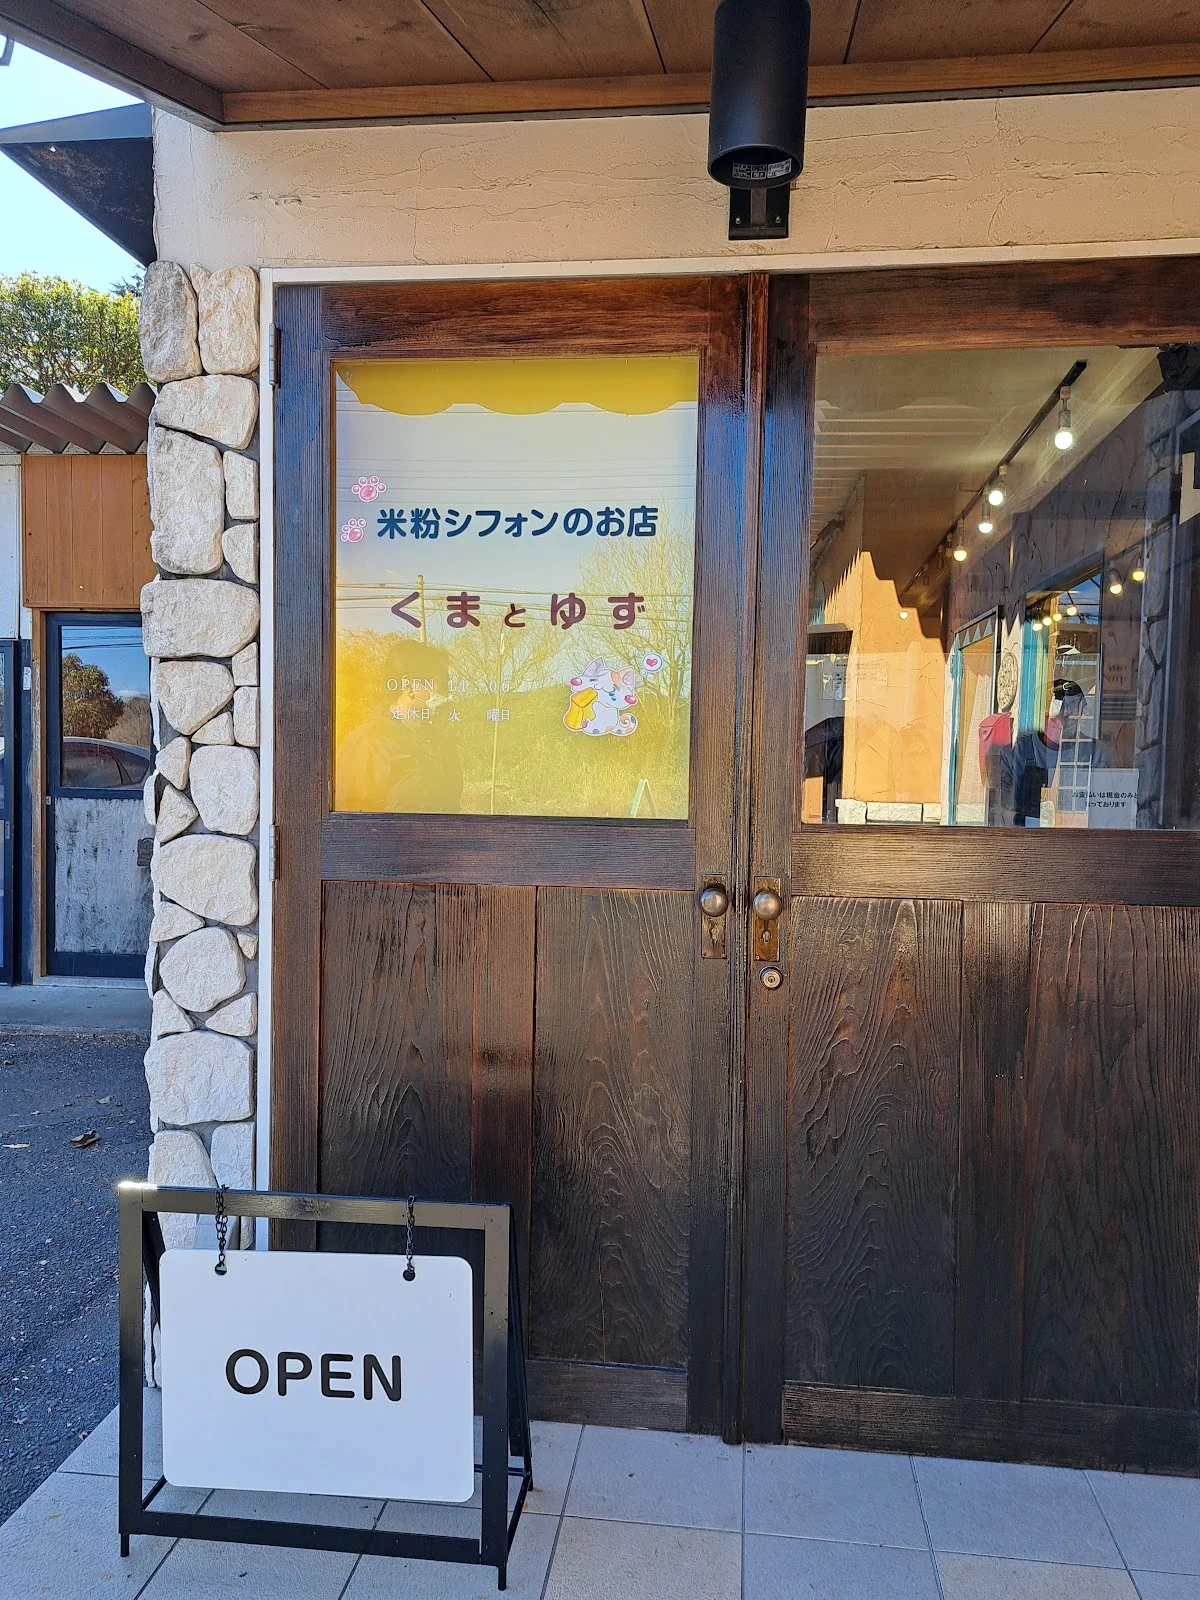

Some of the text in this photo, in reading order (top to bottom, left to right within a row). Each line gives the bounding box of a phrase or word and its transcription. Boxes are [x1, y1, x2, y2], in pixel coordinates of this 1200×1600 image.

[377, 505, 659, 540] 米粉シフォンのお店
[391, 591, 646, 630] くまとゆず
[386, 678, 434, 691] OPEN
[391, 707, 431, 720] 定休日
[225, 1348, 402, 1401] OPEN
